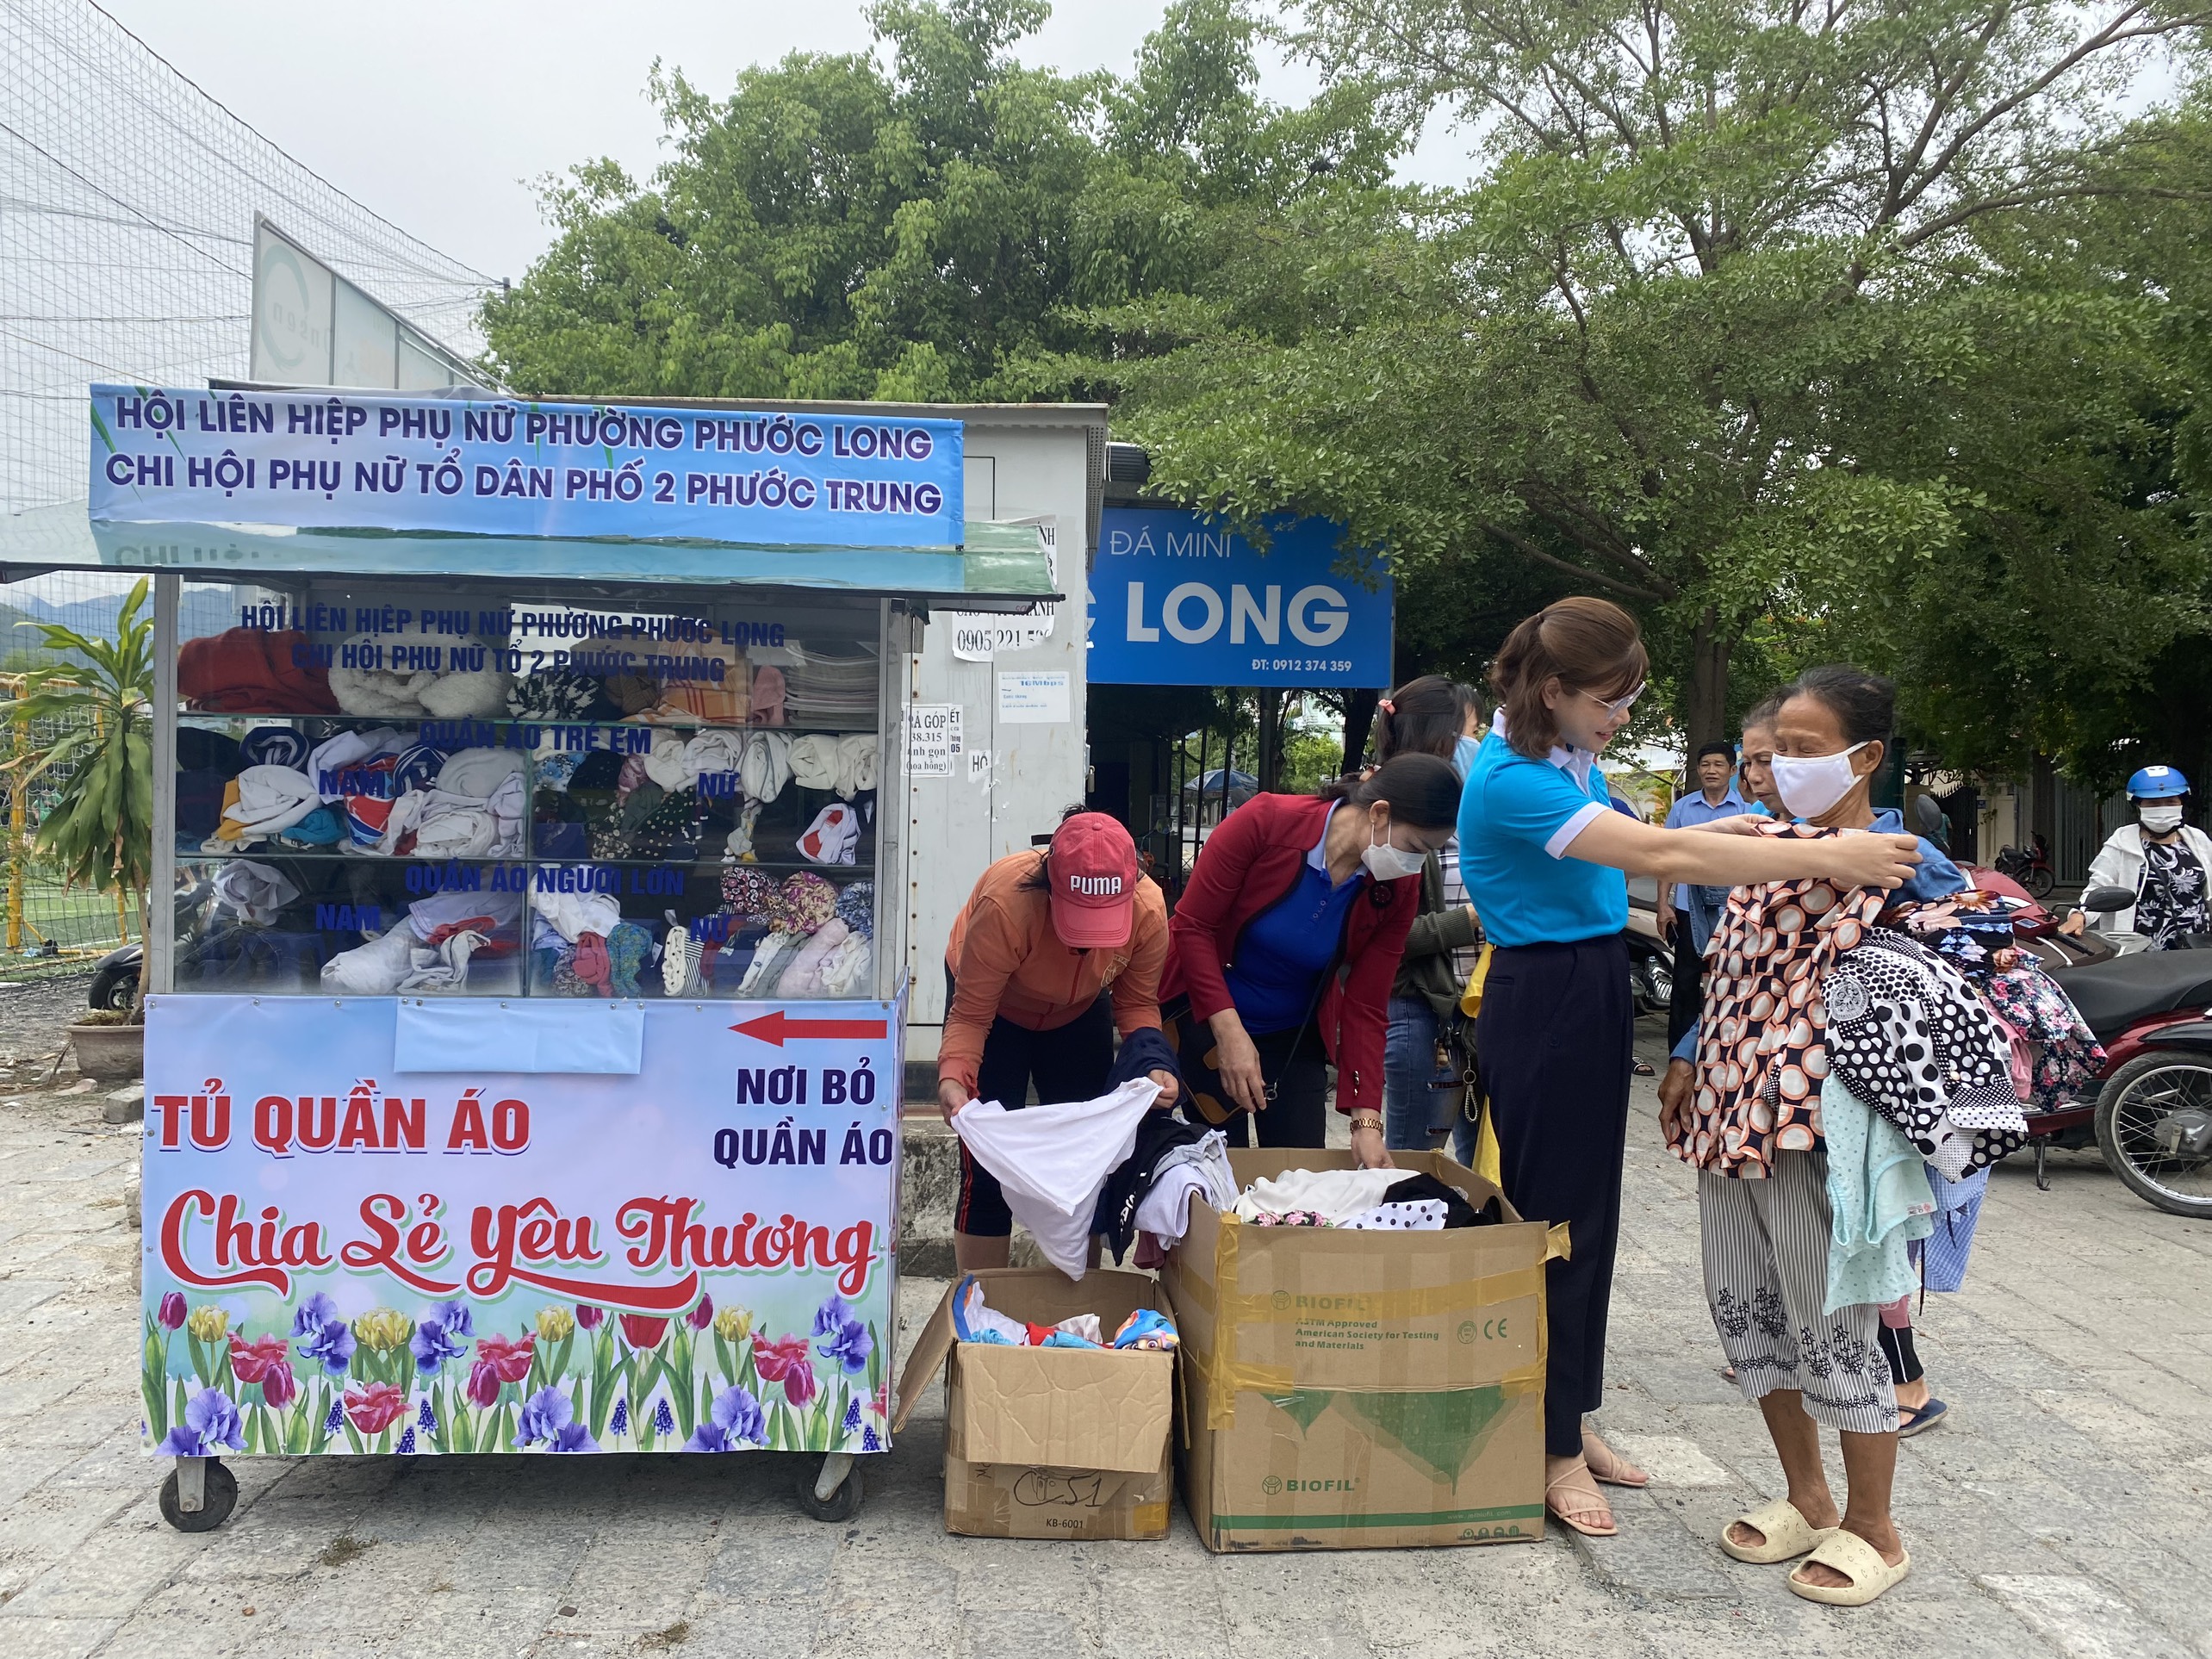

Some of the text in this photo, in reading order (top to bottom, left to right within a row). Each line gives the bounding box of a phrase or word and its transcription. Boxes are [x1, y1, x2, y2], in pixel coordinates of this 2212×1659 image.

[116, 388, 932, 461] HỘI LIÊN HIỆP PHỤ NỮ PHƯỜNG PHƯỚC LONG
[106, 448, 942, 514] CHI HỘI PHỤ NỮ TỔ DÂN PHỐ 2 PHƯỚC TRUNG
[1109, 525, 1232, 557] ĐÁ MINI
[242, 600, 283, 634] HỘI
[293, 603, 346, 631] LIÊN
[356, 604, 412, 637] HIỆP
[421, 610, 469, 639] PHỤ
[479, 606, 515, 636] NỮ
[522, 606, 622, 640] PHƯỜNG
[722, 620, 784, 647] LONG
[1126, 581, 1350, 647] LONG
[958, 630, 992, 651] 0905
[292, 638, 725, 681] CHI HỘI PHỤ NỮ TỔ 2 PHƯỚC TRUNG
[1252, 659, 1351, 672] ĐT: 0912 374 359
[924, 711, 946, 728] GÓP
[505, 719, 541, 750] ÁO
[549, 718, 600, 751] TRẺ
[610, 726, 651, 755] EM
[950, 743, 960, 753] 05
[924, 758, 947, 773] hồng)
[928, 748, 946, 758] gọn
[319, 769, 385, 798] NAM
[698, 769, 739, 799] NỮ
[490, 859, 527, 893] ÁO
[537, 859, 622, 894] NGƯỜI
[631, 862, 684, 896] LỚN
[1070, 874, 1122, 895] PUMA
[315, 902, 381, 931] NAM
[736, 1056, 875, 1105] NƠI BỎ
[151, 1078, 531, 1158] TỦ QUẦN ÁO
[713, 1115, 893, 1169] QUẦN ÁO
[160, 1189, 333, 1297] Chia
[340, 1192, 463, 1292] Sẻ
[615, 1194, 877, 1296] Thương
[1296, 1328, 1344, 1338] American
[1347, 1330, 1383, 1340] Society
[1402, 1332, 1439, 1341] Testing
[1327, 1319, 1377, 1328] Approved
[1317, 1341, 1364, 1350] Materials
[1287, 1479, 1355, 1491] BIOFIL
[1046, 1518, 1084, 1529] KB-6001
